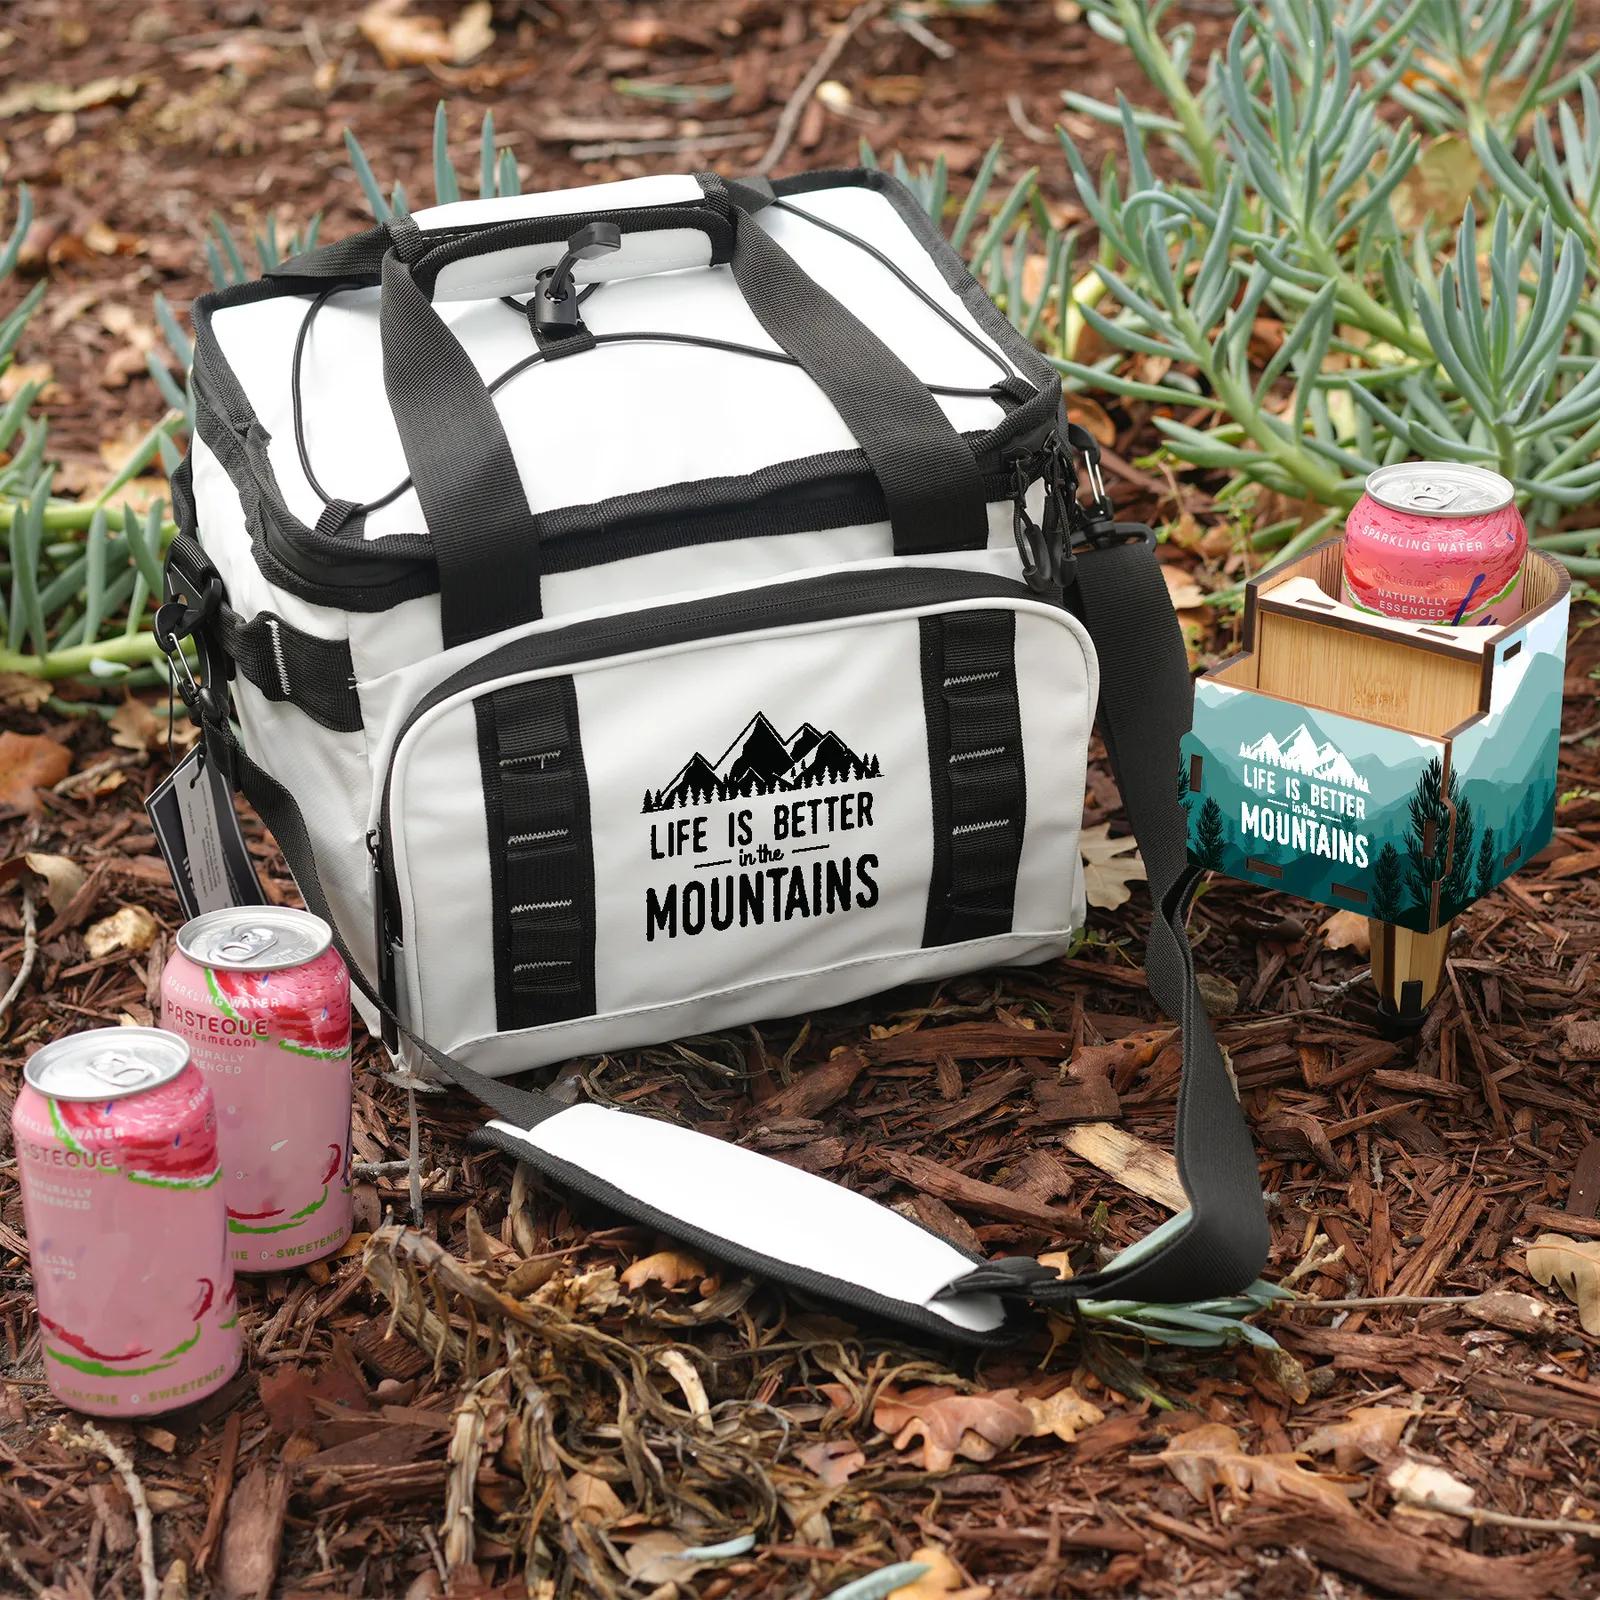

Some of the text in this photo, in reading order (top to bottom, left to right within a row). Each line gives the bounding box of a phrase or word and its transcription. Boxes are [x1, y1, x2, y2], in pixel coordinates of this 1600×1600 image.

[1362, 525, 1483, 553] SPARKLING WATER
[1377, 588, 1449, 606] NATURALLY
[1379, 600, 1445, 617] ESSENCED
[1243, 764, 1366, 820] LIFE IS BETTER
[650, 791, 874, 860] LIFE IS BETTER
[1241, 801, 1369, 869] MOUNTAINS
[738, 843, 784, 867] in the
[646, 853, 880, 942] MOUNTAINS
[231, 997, 280, 1009] WATER
[167, 1000, 268, 1036] PASTEQUE
[73, 1126, 125, 1141] WATER
